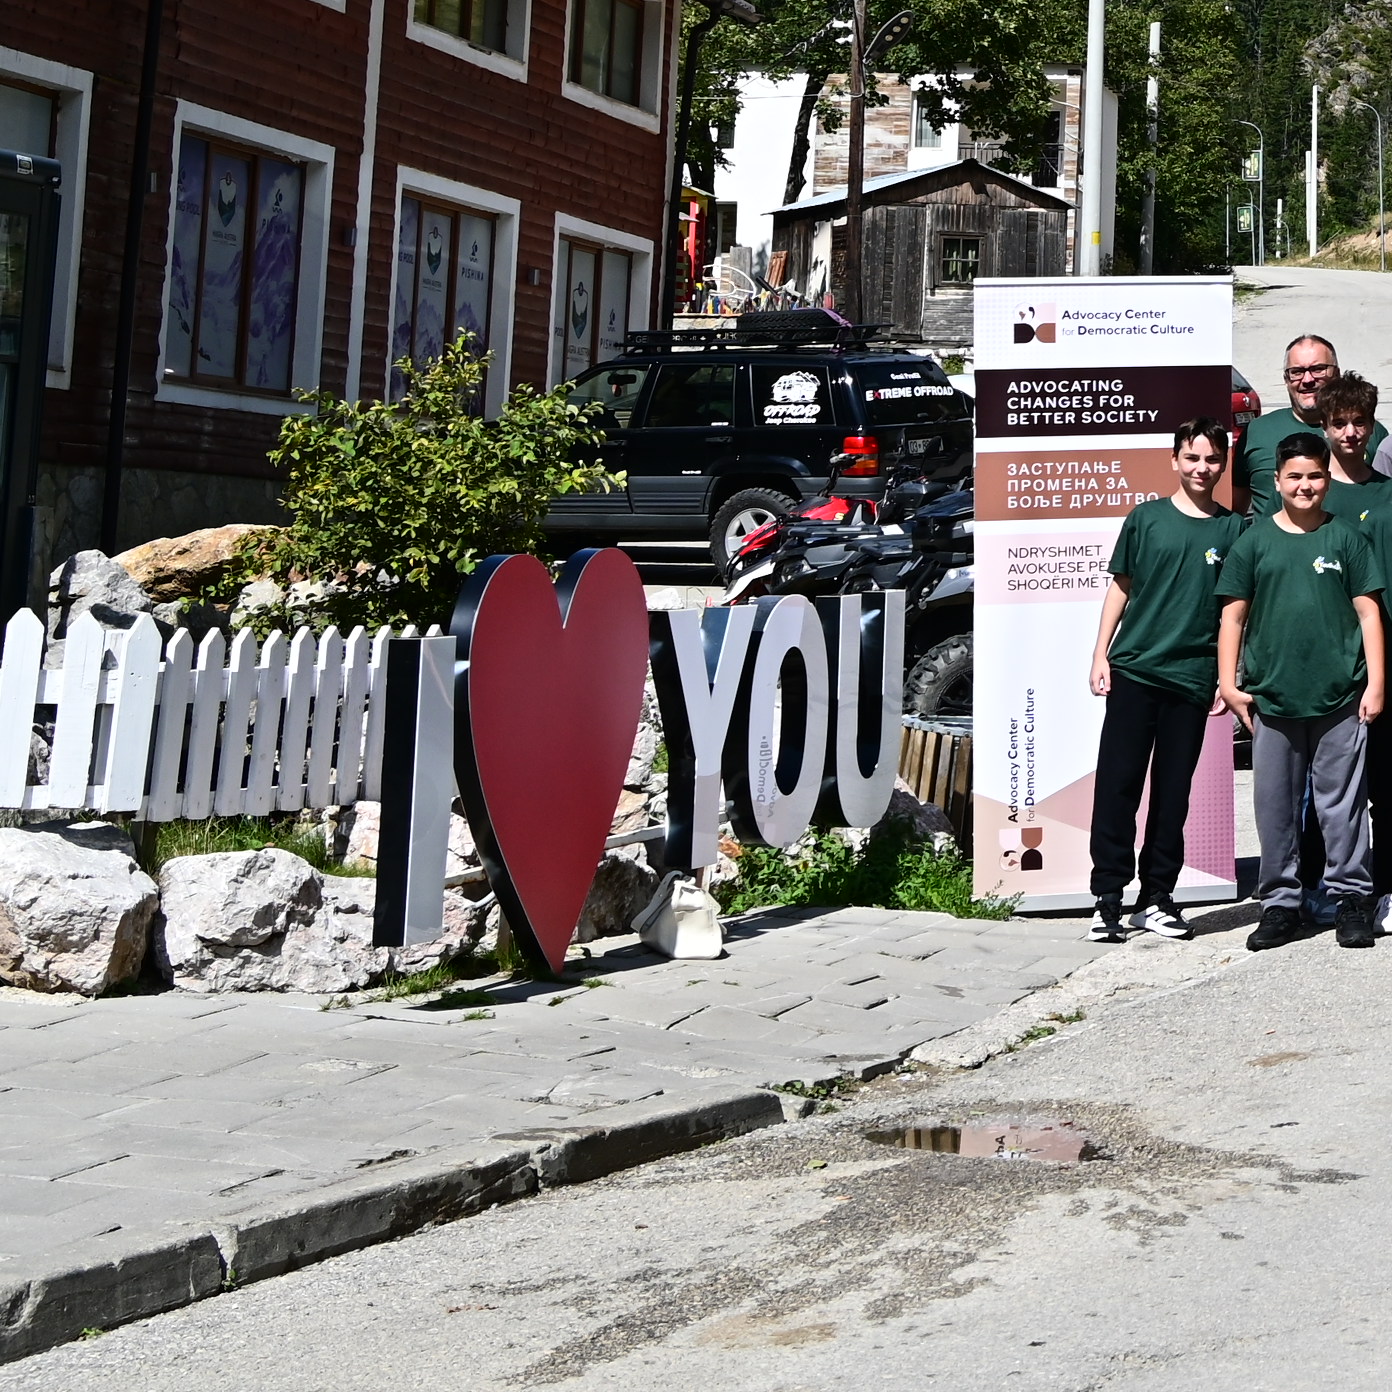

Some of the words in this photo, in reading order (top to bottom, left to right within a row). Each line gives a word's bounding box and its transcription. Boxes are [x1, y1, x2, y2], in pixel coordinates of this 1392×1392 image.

[1061, 310, 1122, 322] Advocacy
[1125, 309, 1166, 319] Center
[1062, 327, 1075, 336] for
[1077, 324, 1147, 336] Democratic
[1150, 324, 1195, 335] Culture
[865, 386, 912, 402] EXTREME
[913, 385, 954, 397] OFFROAD
[1006, 379, 1124, 394] ADVOCATING
[1007, 396, 1093, 409] CHANGES
[1099, 394, 1135, 408] FOR
[1007, 412, 1076, 425] BETTER
[1081, 409, 1159, 424] SOCIETY
[1007, 461, 1121, 476] ЗАСТУПАЊЕ
[1007, 477, 1099, 492] ПРОМЕНА
[1105, 476, 1129, 489] ЗА
[1007, 494, 1063, 509] БОЉЕ
[1008, 544, 1103, 559] NDRYSHIMET
[1008, 561, 1086, 575] AVOKUESE
[1089, 557, 1110, 572] PË
[1008, 574, 1074, 591] SHOQËRI
[1078, 574, 1099, 589] MË
[1102, 576, 1112, 588] T
[1024, 687, 1036, 734] Culture
[649, 589, 906, 870] YOU
[1007, 717, 1019, 760] Center
[1024, 735, 1036, 806] Democratic
[1007, 763, 1020, 823] Advocacy
[1026, 807, 1035, 822] for
